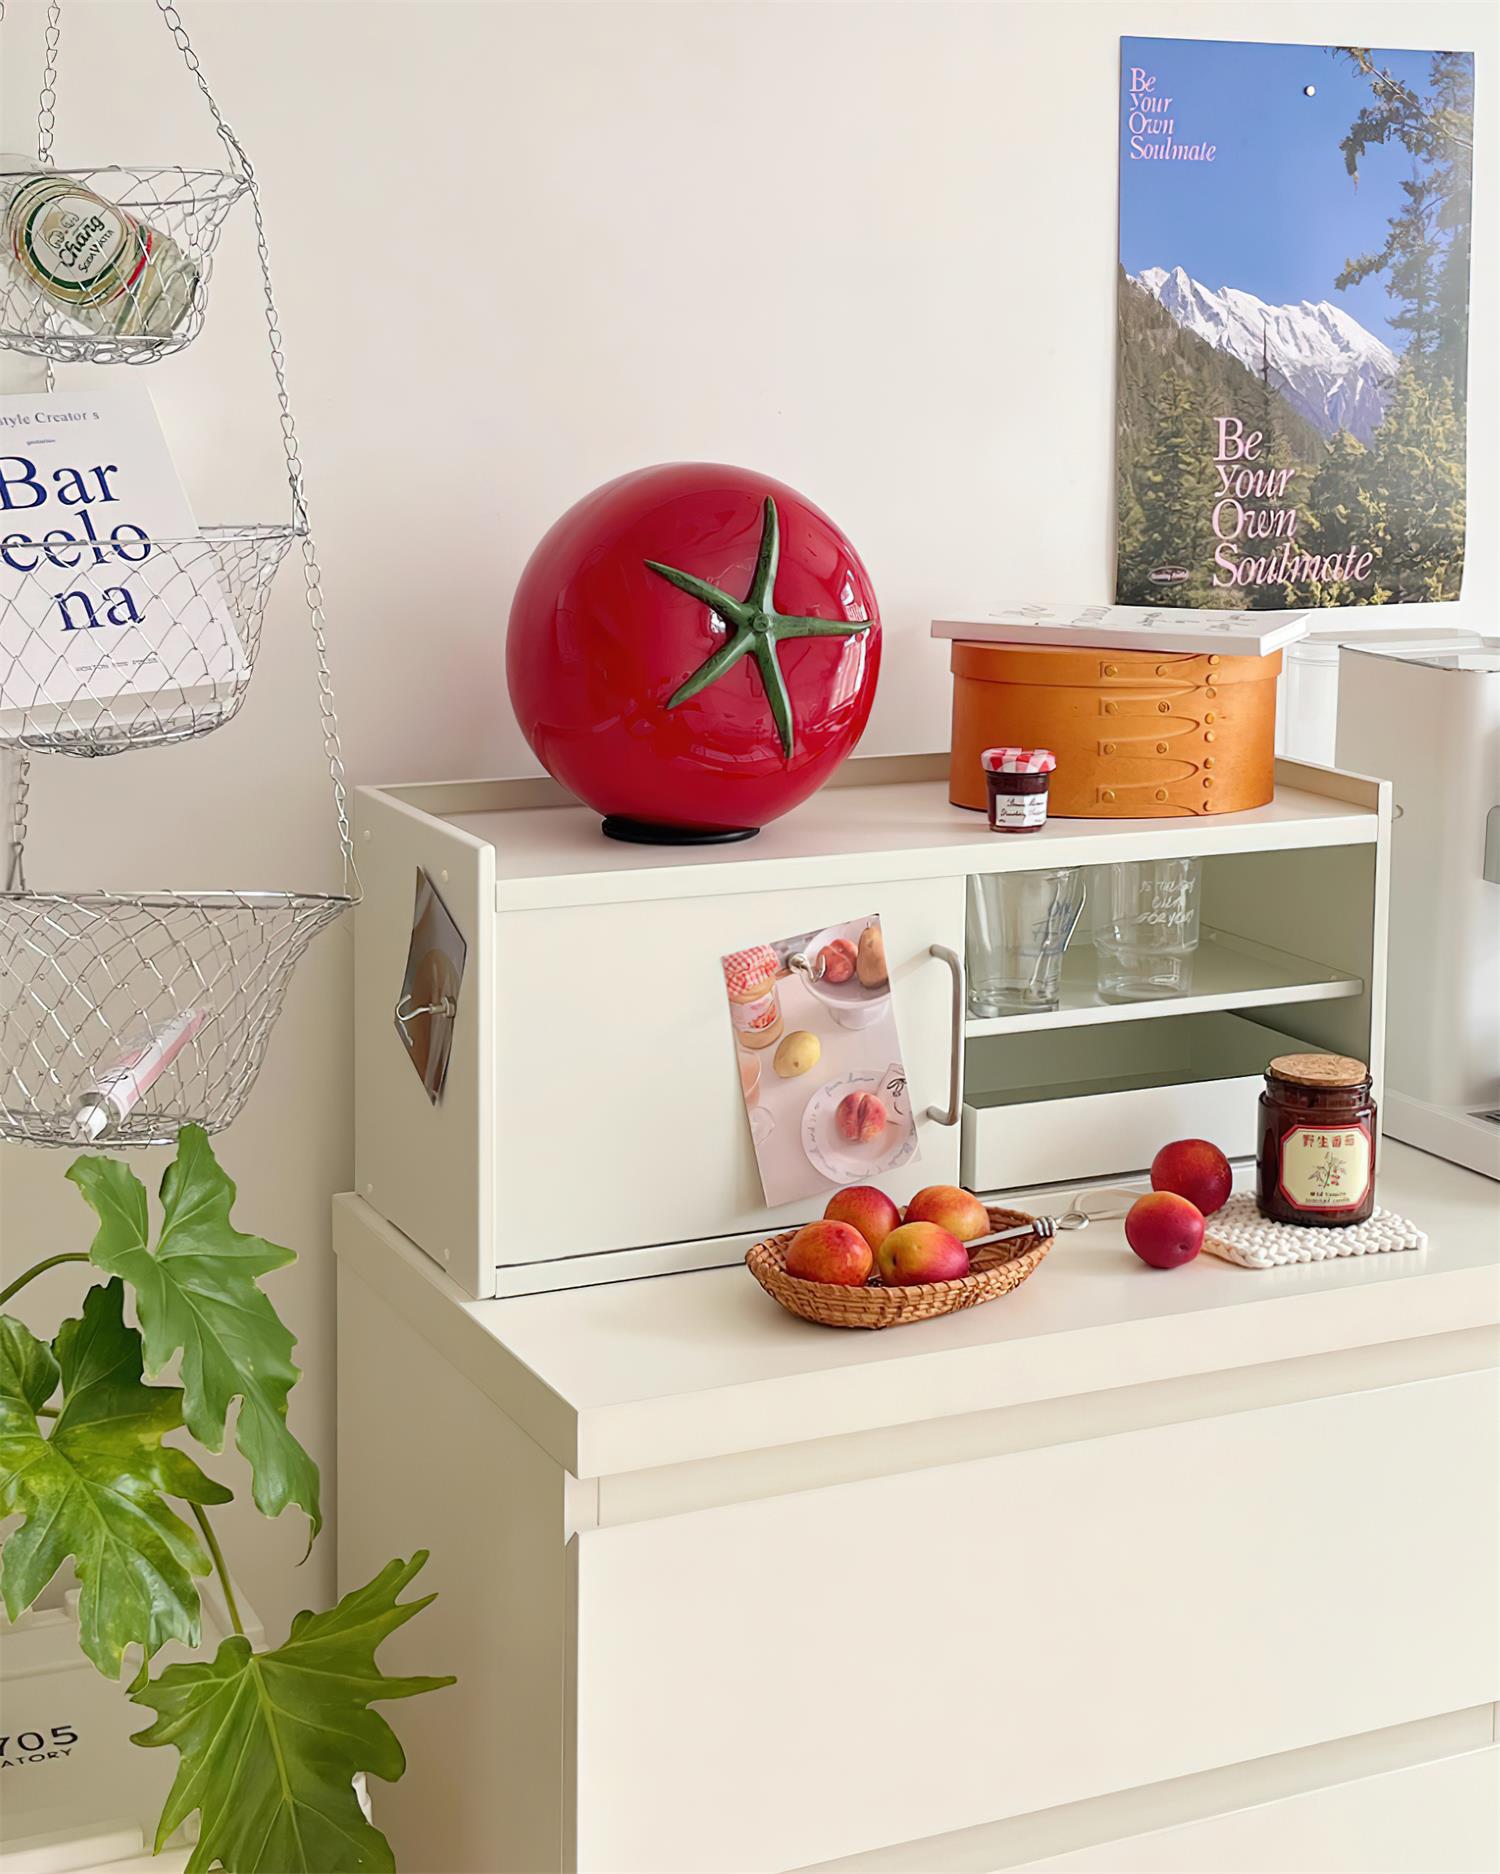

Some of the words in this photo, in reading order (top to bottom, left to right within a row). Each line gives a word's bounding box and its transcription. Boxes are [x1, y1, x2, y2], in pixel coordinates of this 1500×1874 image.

[1128, 67, 1157, 93] Be
[1128, 111, 1175, 135] Own
[1129, 135, 1217, 162] Soulmate
[59, 215, 105, 268] Chang
[1212, 416, 1263, 462] Be
[0, 456, 121, 511] Bar
[1211, 498, 1298, 541] Own
[1212, 542, 1374, 588] Soulmate
[54, 586, 147, 632] na
